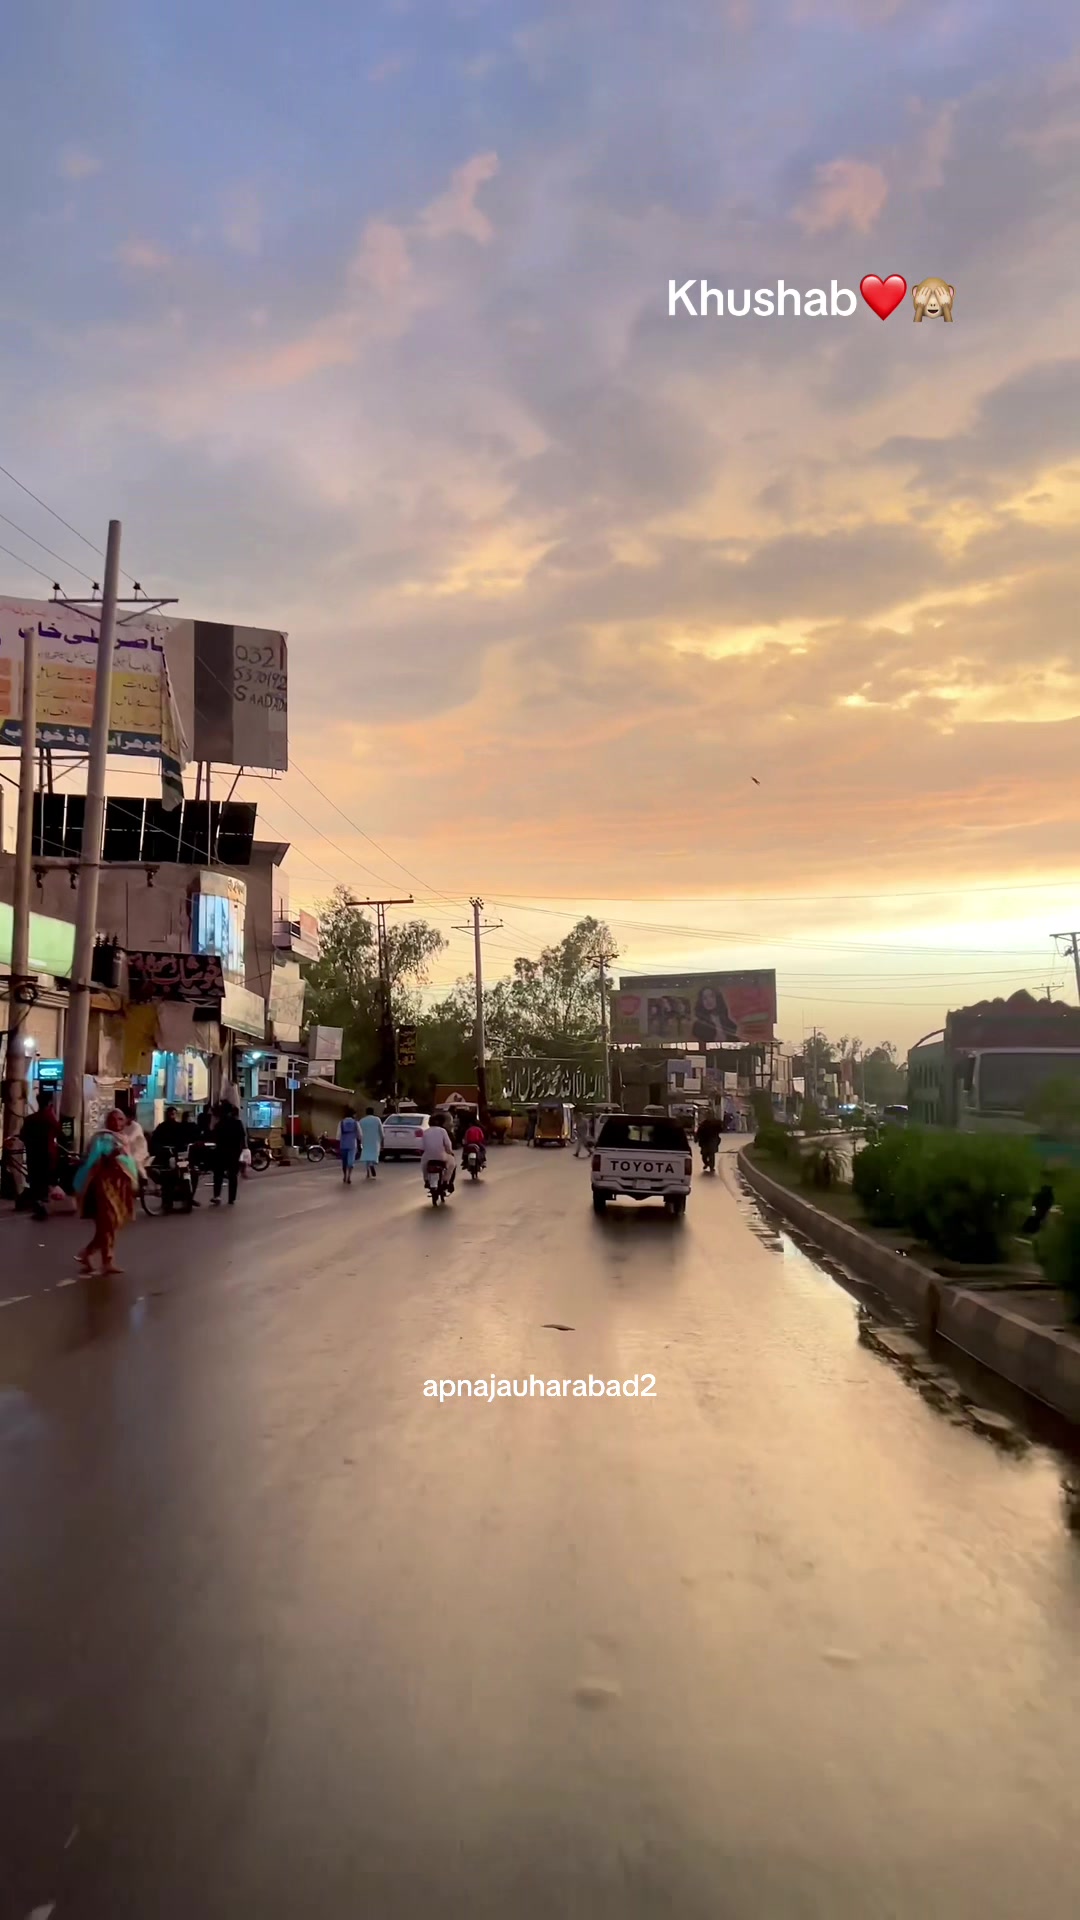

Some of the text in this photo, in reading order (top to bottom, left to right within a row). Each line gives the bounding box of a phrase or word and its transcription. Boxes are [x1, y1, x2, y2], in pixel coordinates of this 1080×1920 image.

[63, 628, 101, 645] لی
[235, 642, 284, 671] 0321
[611, 1161, 675, 1173] TOYOTA
